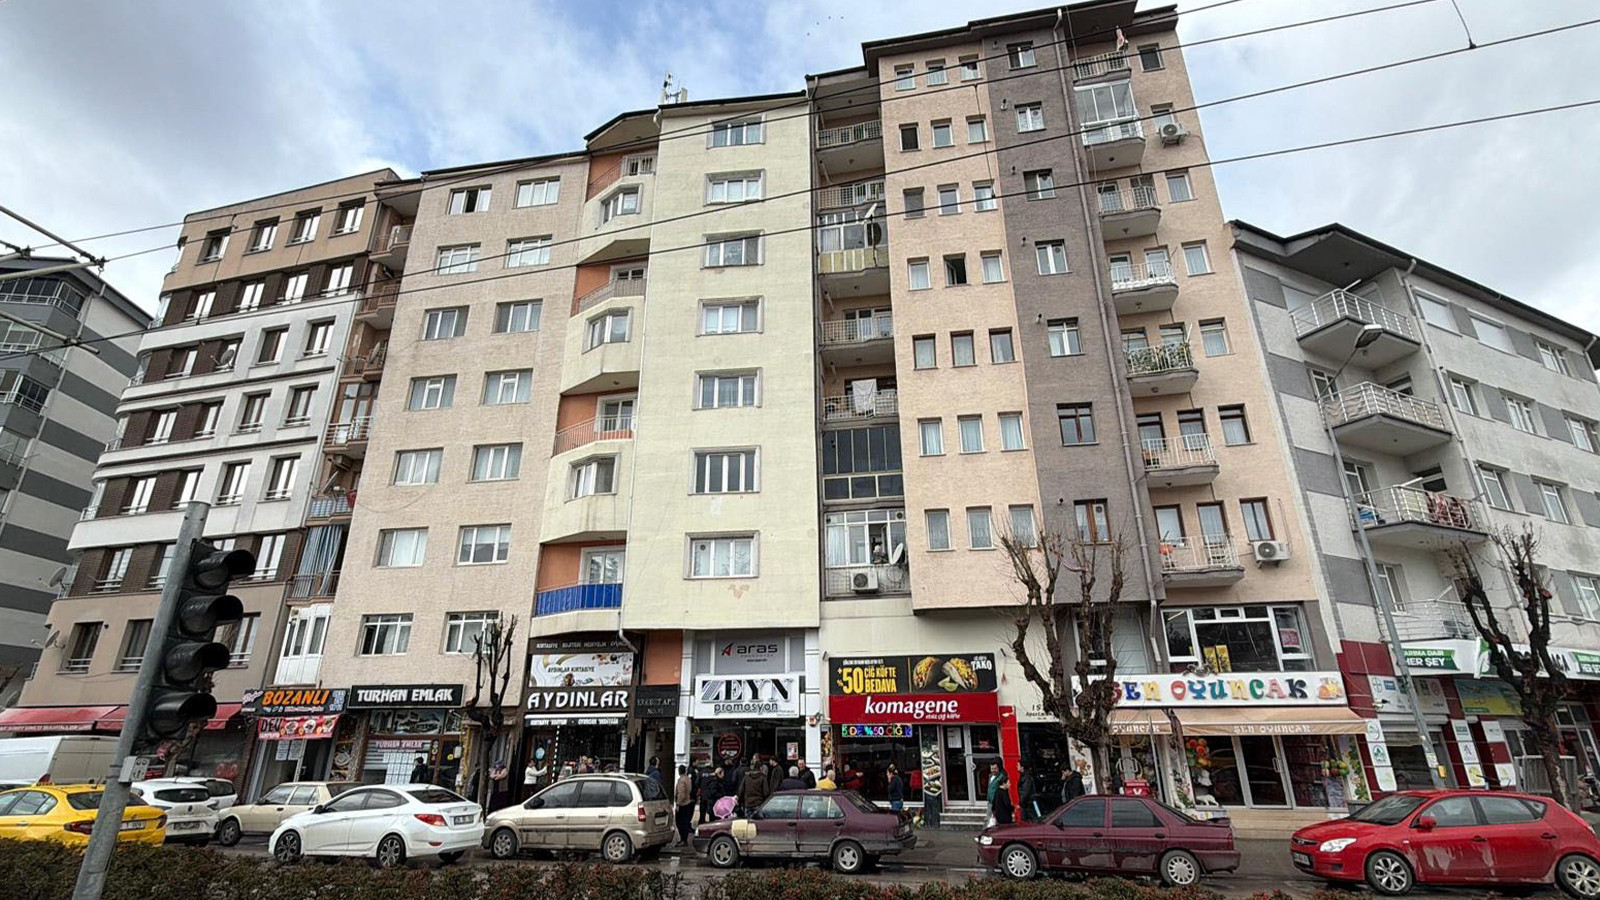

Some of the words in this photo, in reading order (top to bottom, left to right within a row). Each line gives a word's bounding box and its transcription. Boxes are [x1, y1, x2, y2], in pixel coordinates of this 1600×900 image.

[737, 644, 778, 654] aras
[971, 660, 992, 671] TAKO
[1425, 657, 1446, 667] ŞEY
[701, 678, 794, 703] ZEYN
[865, 678, 897, 693] BEDAVA
[1171, 679, 1308, 700] OYUNCAK
[261, 690, 330, 706] BOZANLI
[357, 689, 408, 703] TURHAN
[411, 688, 454, 702] EMLAK
[527, 691, 628, 709] AYDINLAR
[714, 703, 778, 714] promosyon
[865, 696, 958, 719] komagene
[1260, 724, 1311, 733] OYUNCAK
